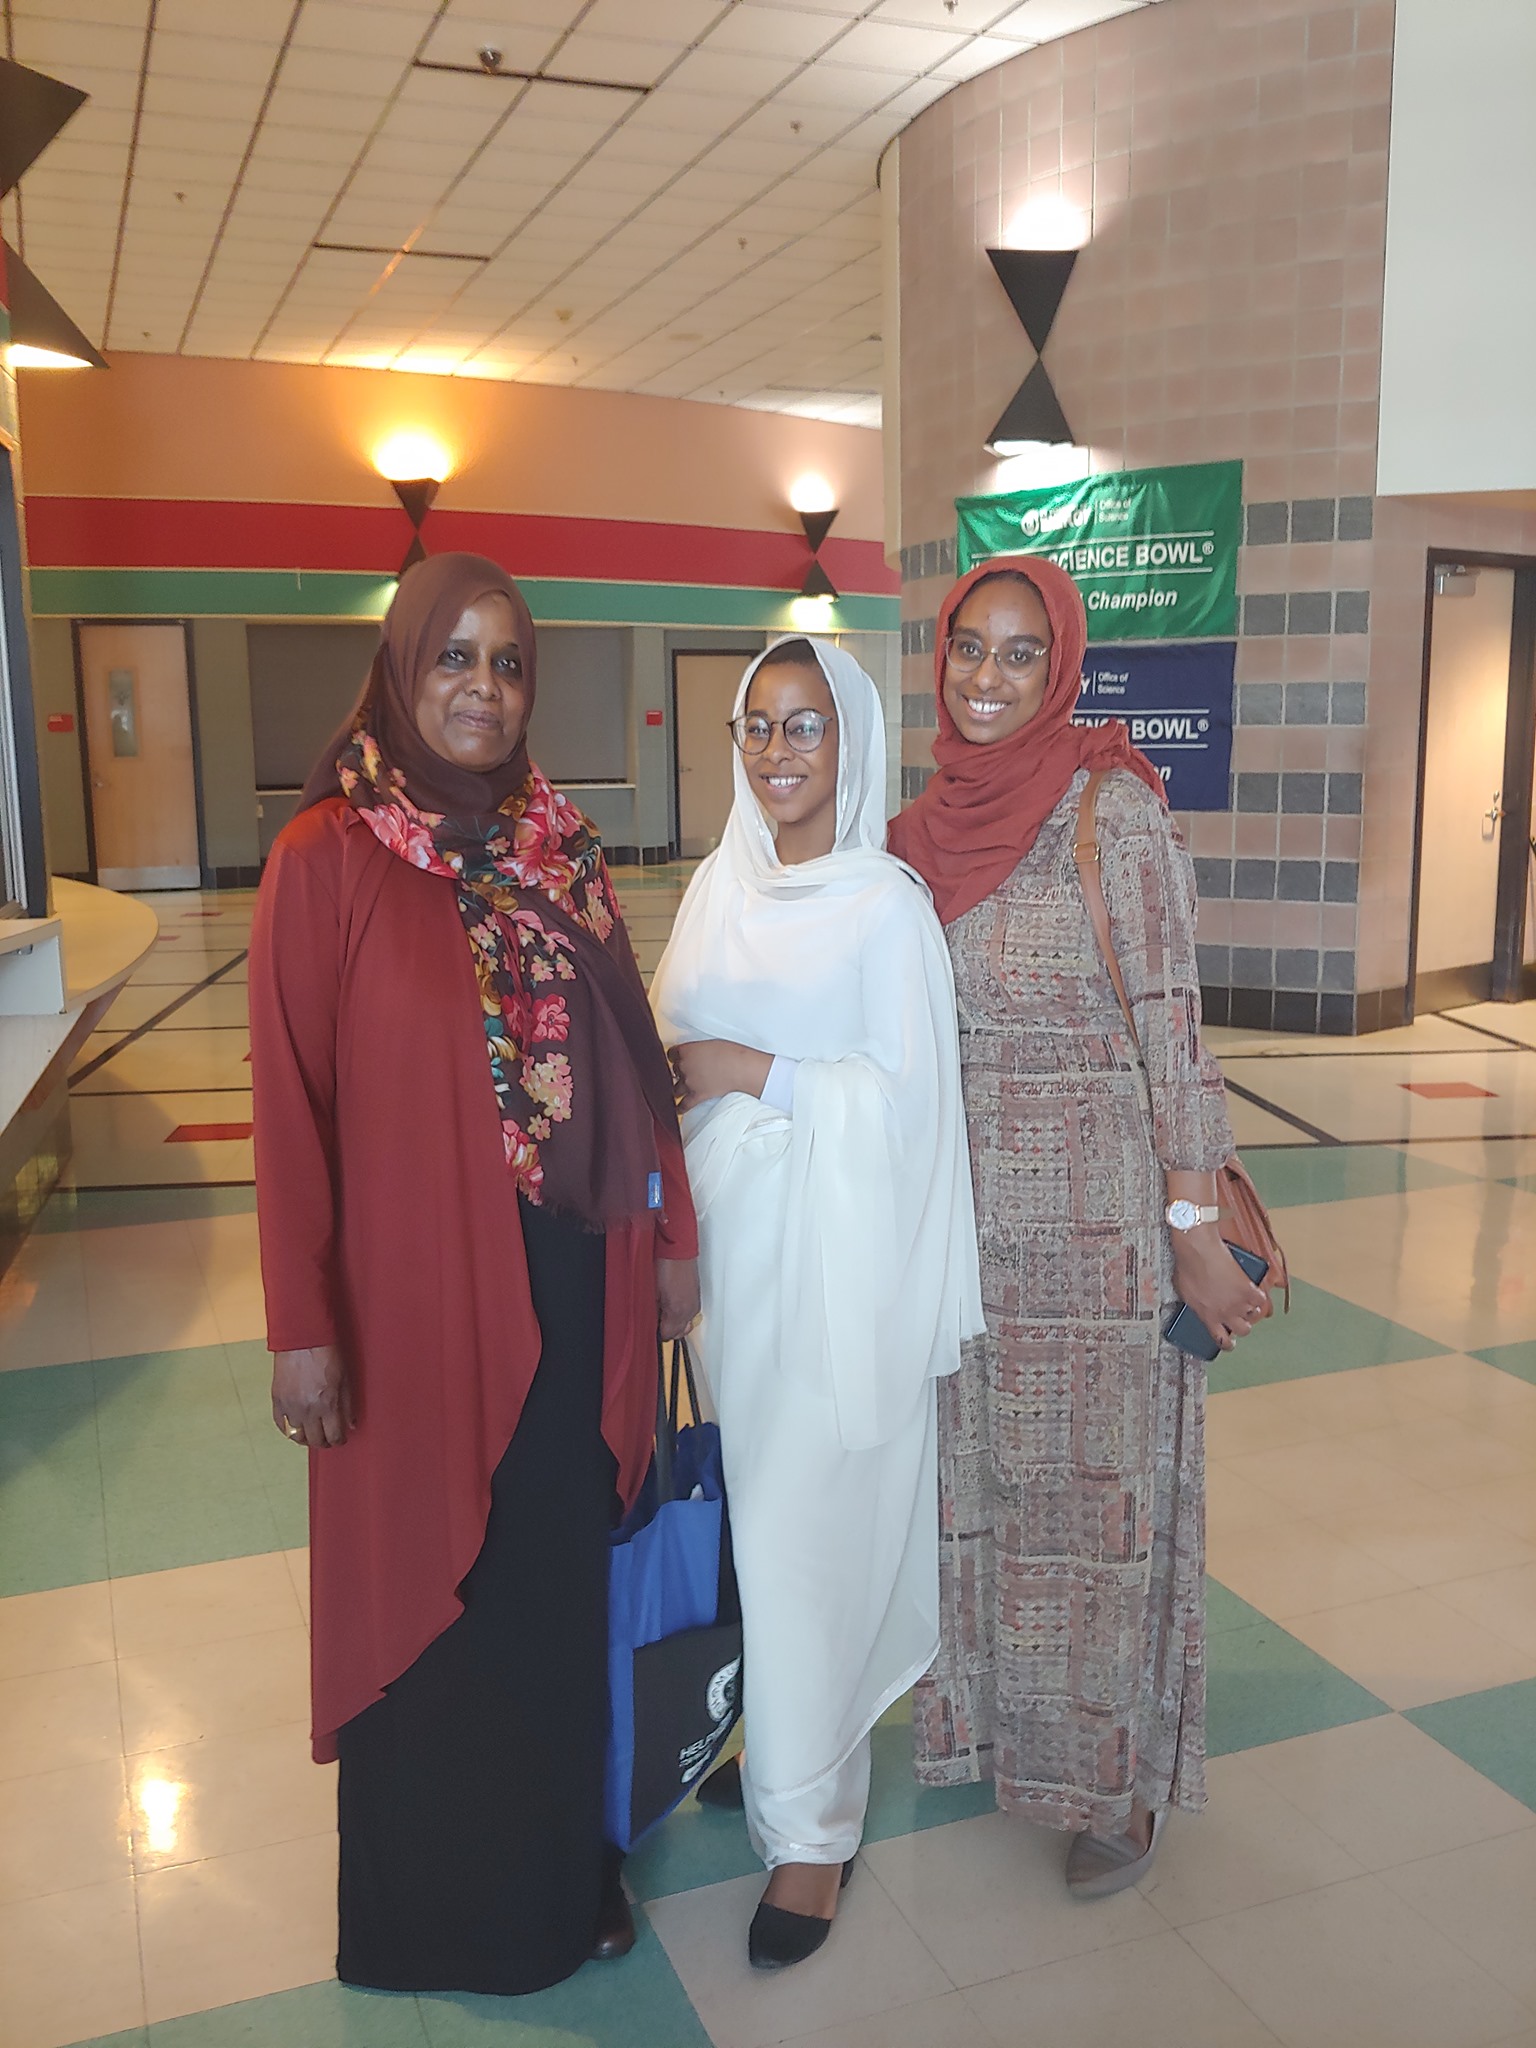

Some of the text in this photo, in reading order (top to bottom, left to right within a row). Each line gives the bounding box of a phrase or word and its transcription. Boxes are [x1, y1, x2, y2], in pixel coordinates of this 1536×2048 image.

[1087, 588, 1178, 613] Champion
[1097, 671, 1129, 683] Office of
[1097, 684, 1126, 695] Science
